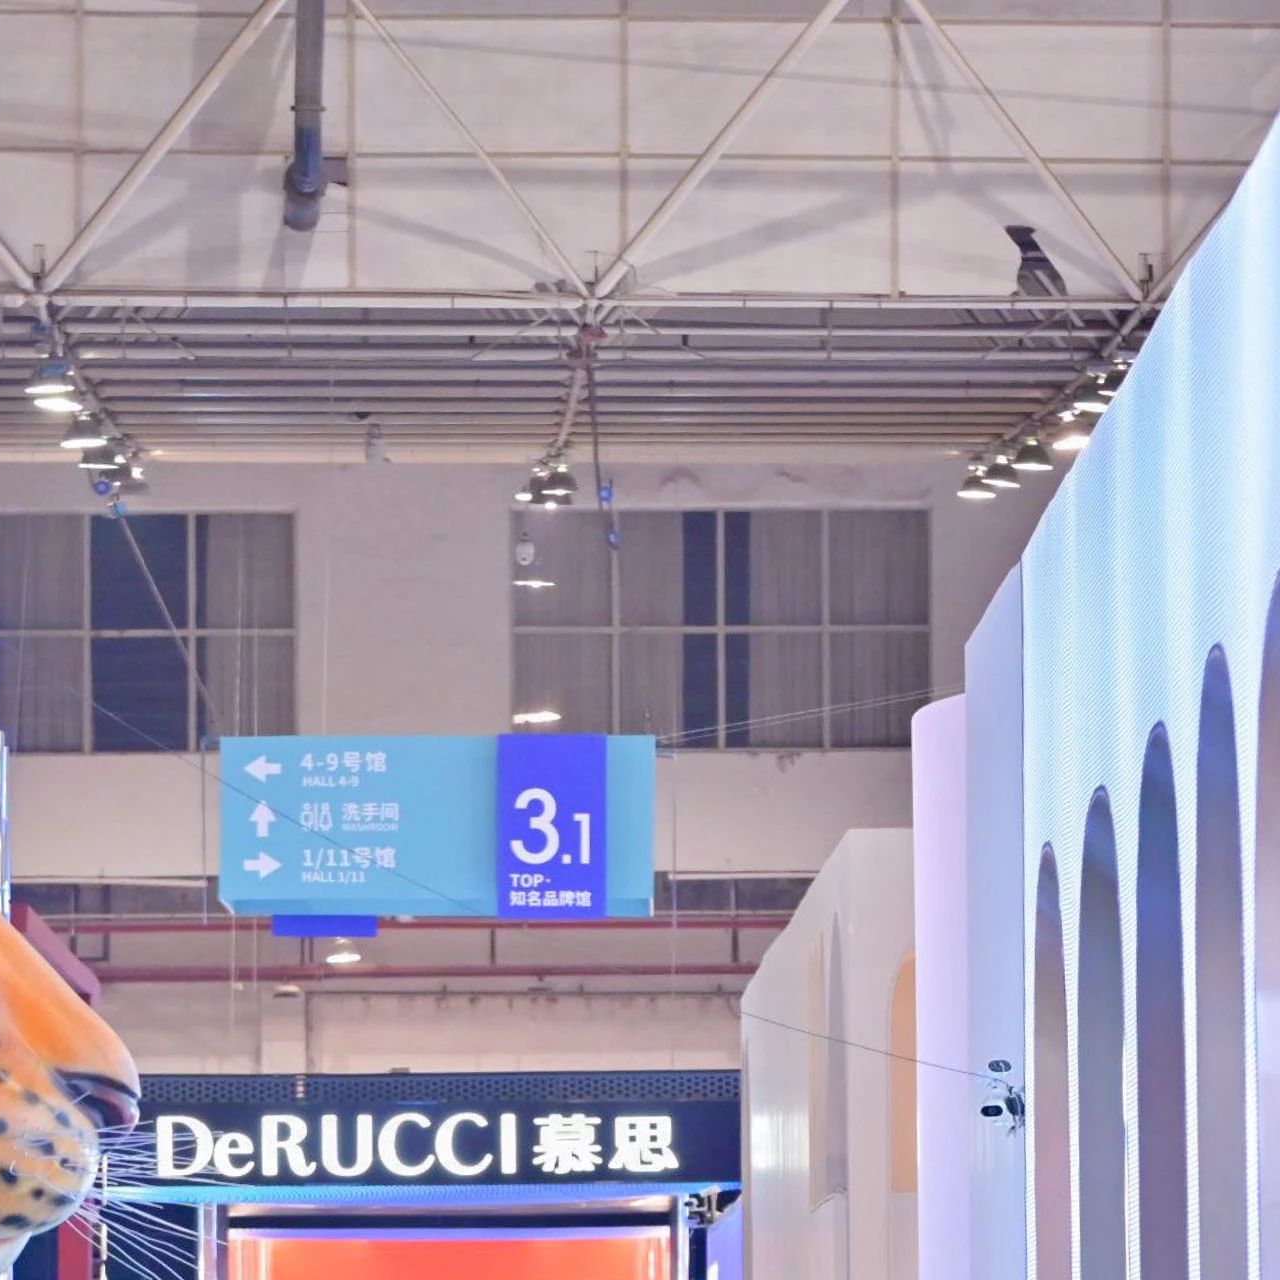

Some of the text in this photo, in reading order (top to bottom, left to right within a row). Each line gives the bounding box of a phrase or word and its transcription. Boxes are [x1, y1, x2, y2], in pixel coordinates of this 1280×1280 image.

[300, 751, 387, 773] 4-9号馆
[303, 776, 336, 787] HALL
[341, 802, 399, 821] 洗手间
[510, 787, 591, 865] 3.1
[302, 847, 396, 870] 1/11号馆
[302, 871, 366, 884] HALL 1/11
[509, 891, 592, 908] 知名品牌馆
[155, 1111, 679, 1178] DeRUCCI 慕思
